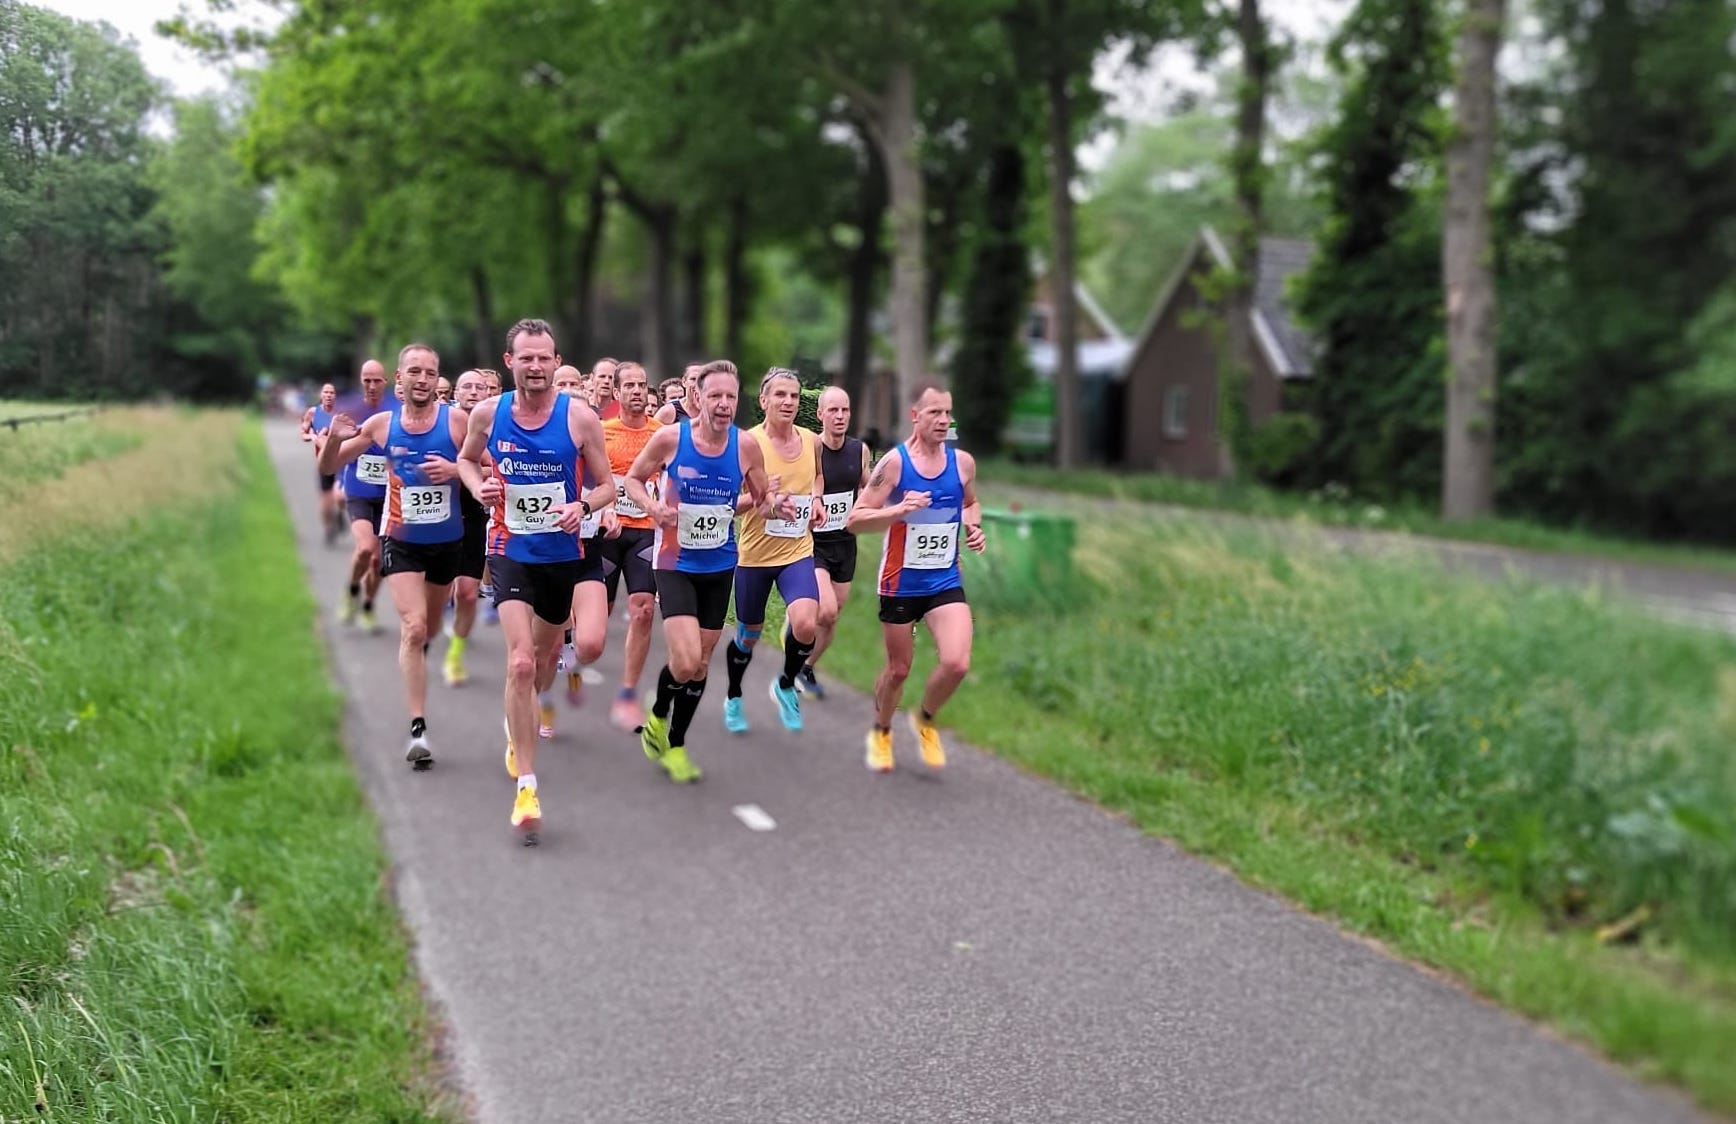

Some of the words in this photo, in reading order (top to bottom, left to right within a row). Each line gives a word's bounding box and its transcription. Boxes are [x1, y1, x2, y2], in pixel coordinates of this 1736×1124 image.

[365, 462, 386, 472] 757
[513, 461, 563, 472] Klaverblad
[410, 491, 443, 507] 393
[516, 496, 553, 513] 432
[416, 507, 441, 515] Erwin
[525, 515, 546, 525] Guy
[693, 516, 718, 531] 49
[690, 531, 719, 540] Michel
[917, 535, 949, 550] 958
